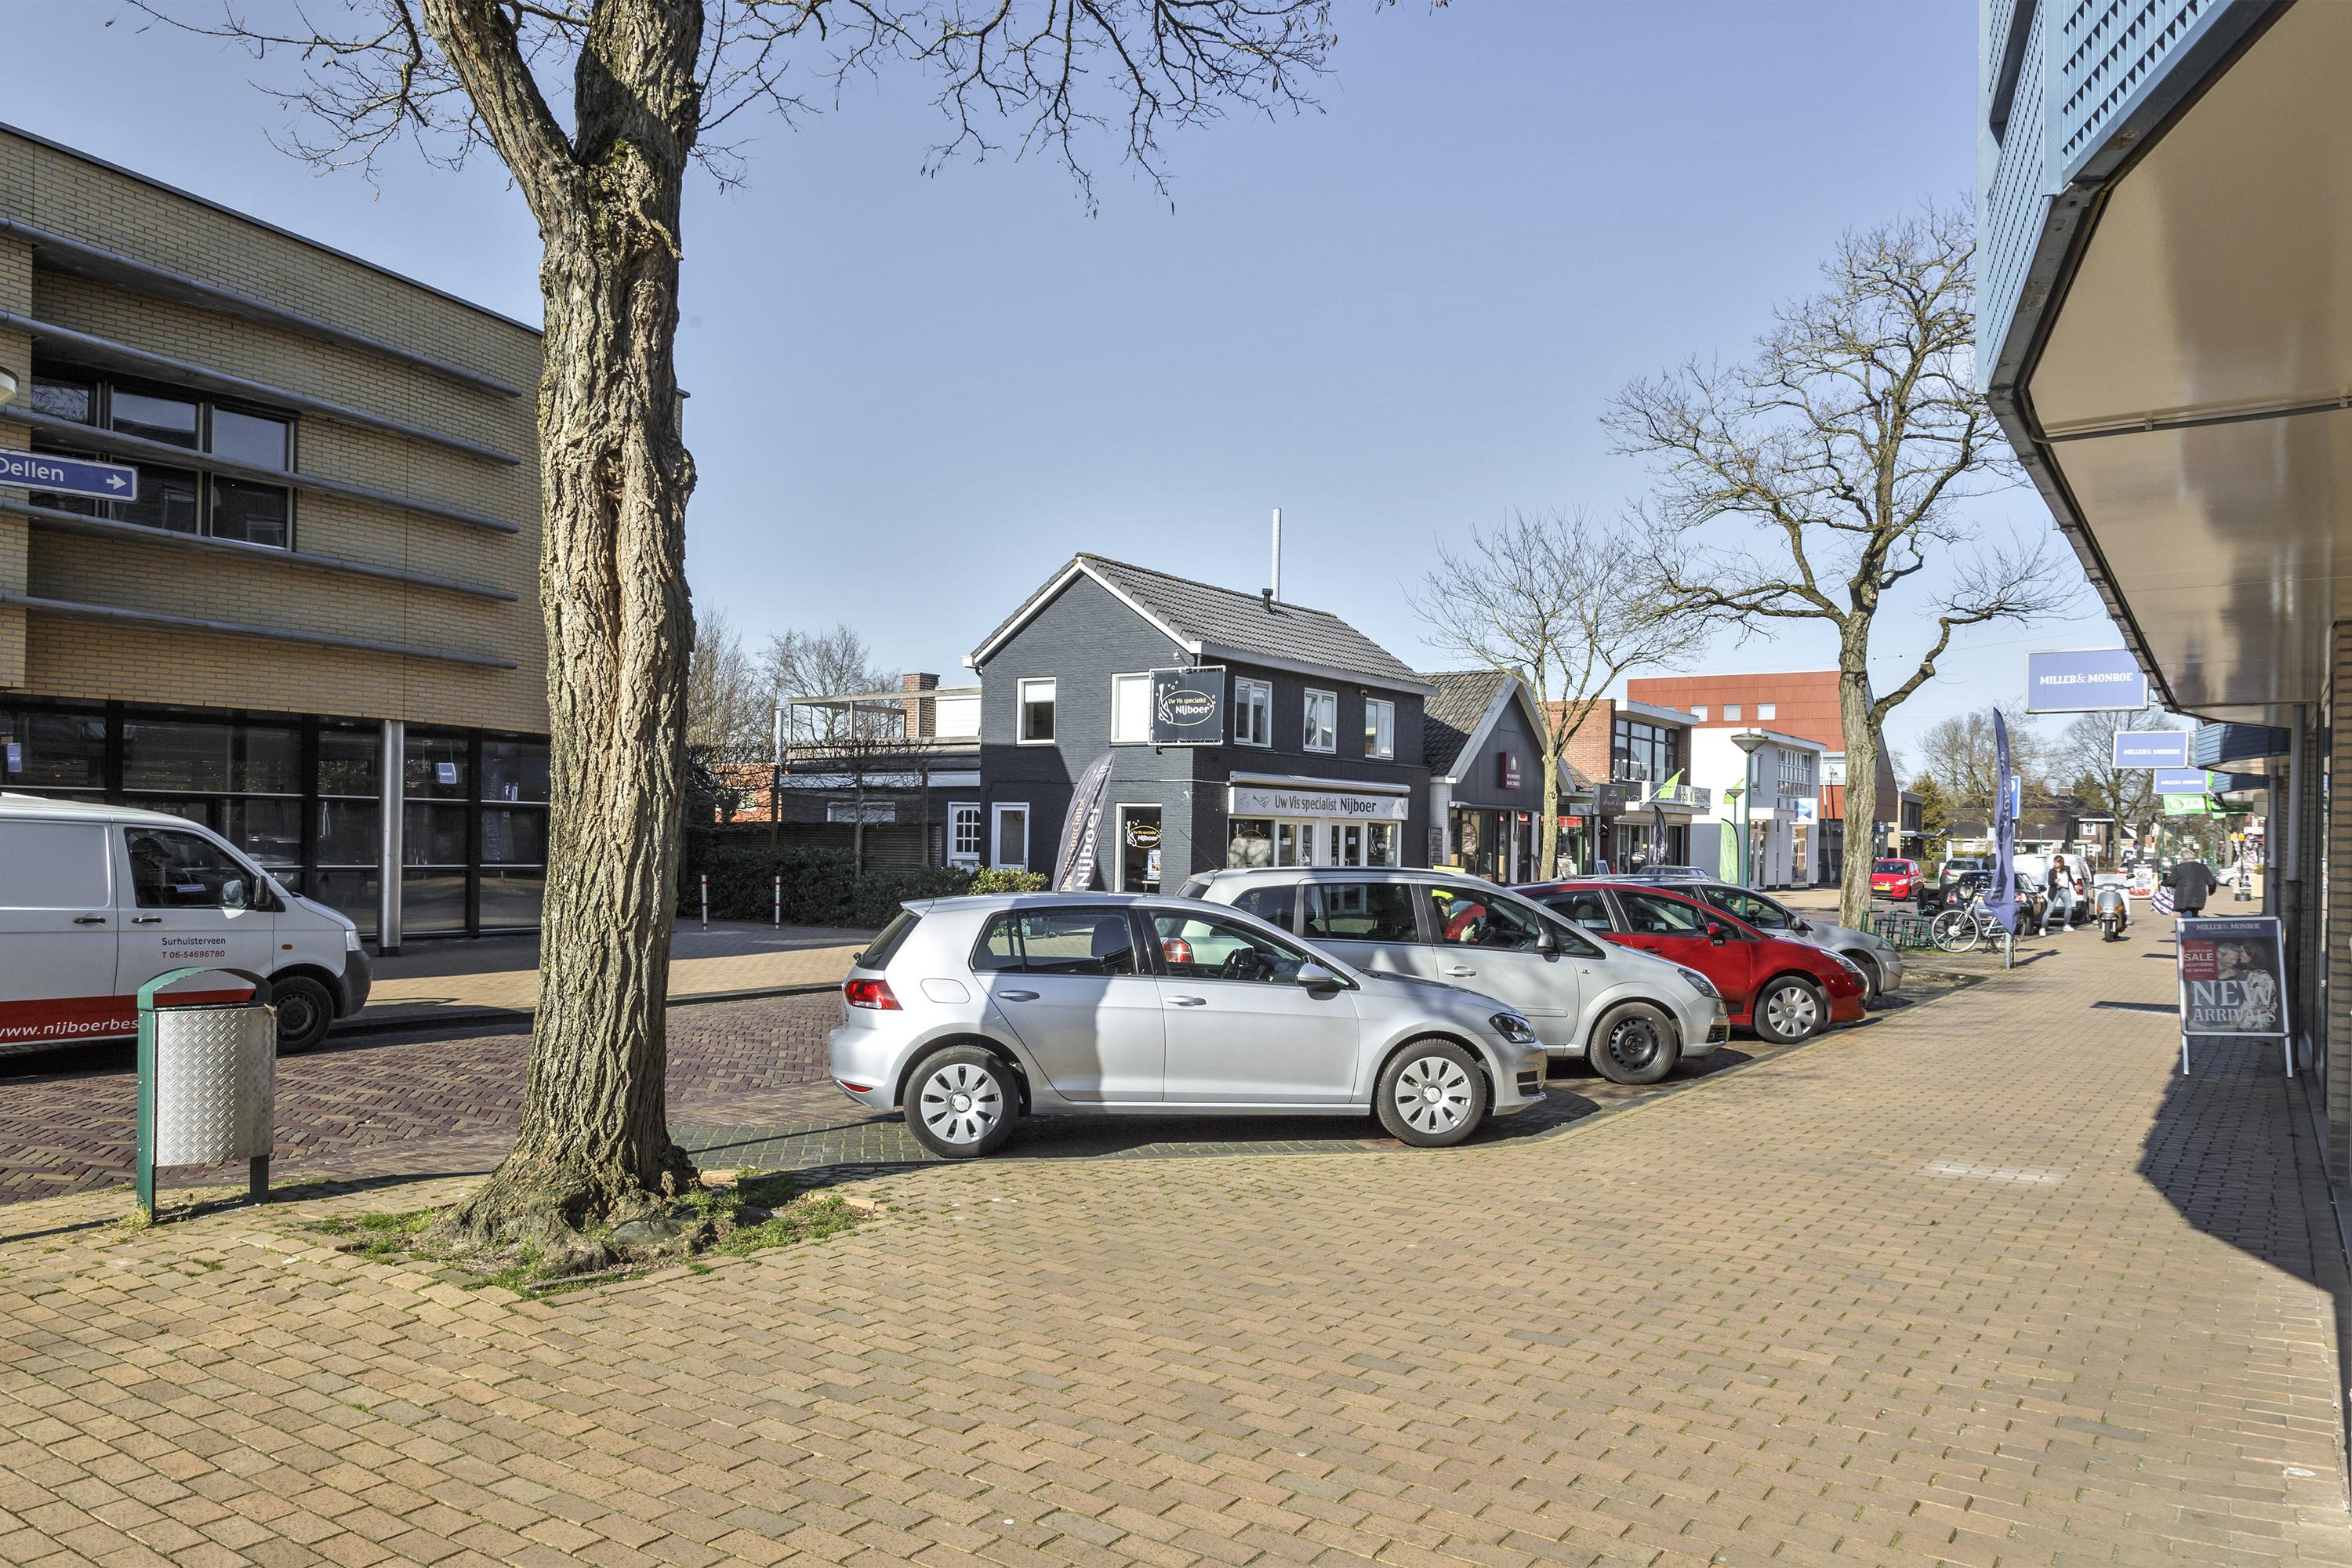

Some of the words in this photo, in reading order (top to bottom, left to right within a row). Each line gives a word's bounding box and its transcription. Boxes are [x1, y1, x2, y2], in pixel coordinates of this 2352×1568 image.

[2088, 672, 2133, 683] MONROE
[1176, 705, 1210, 715] Nijboer
[1275, 795, 1287, 808] Uw
[1289, 796, 1301, 809] Vis
[1301, 797, 1338, 811] specialist
[1340, 797, 1377, 815] Nijboer
[1076, 803, 1100, 887] Nijboer
[162, 937, 226, 946] Surhuisterveen
[169, 949, 226, 958] 06-54696780
[2184, 953, 2214, 961] SALE
[2191, 980, 2274, 1007] NEW
[2193, 1008, 2276, 1022] ARRIVALS
